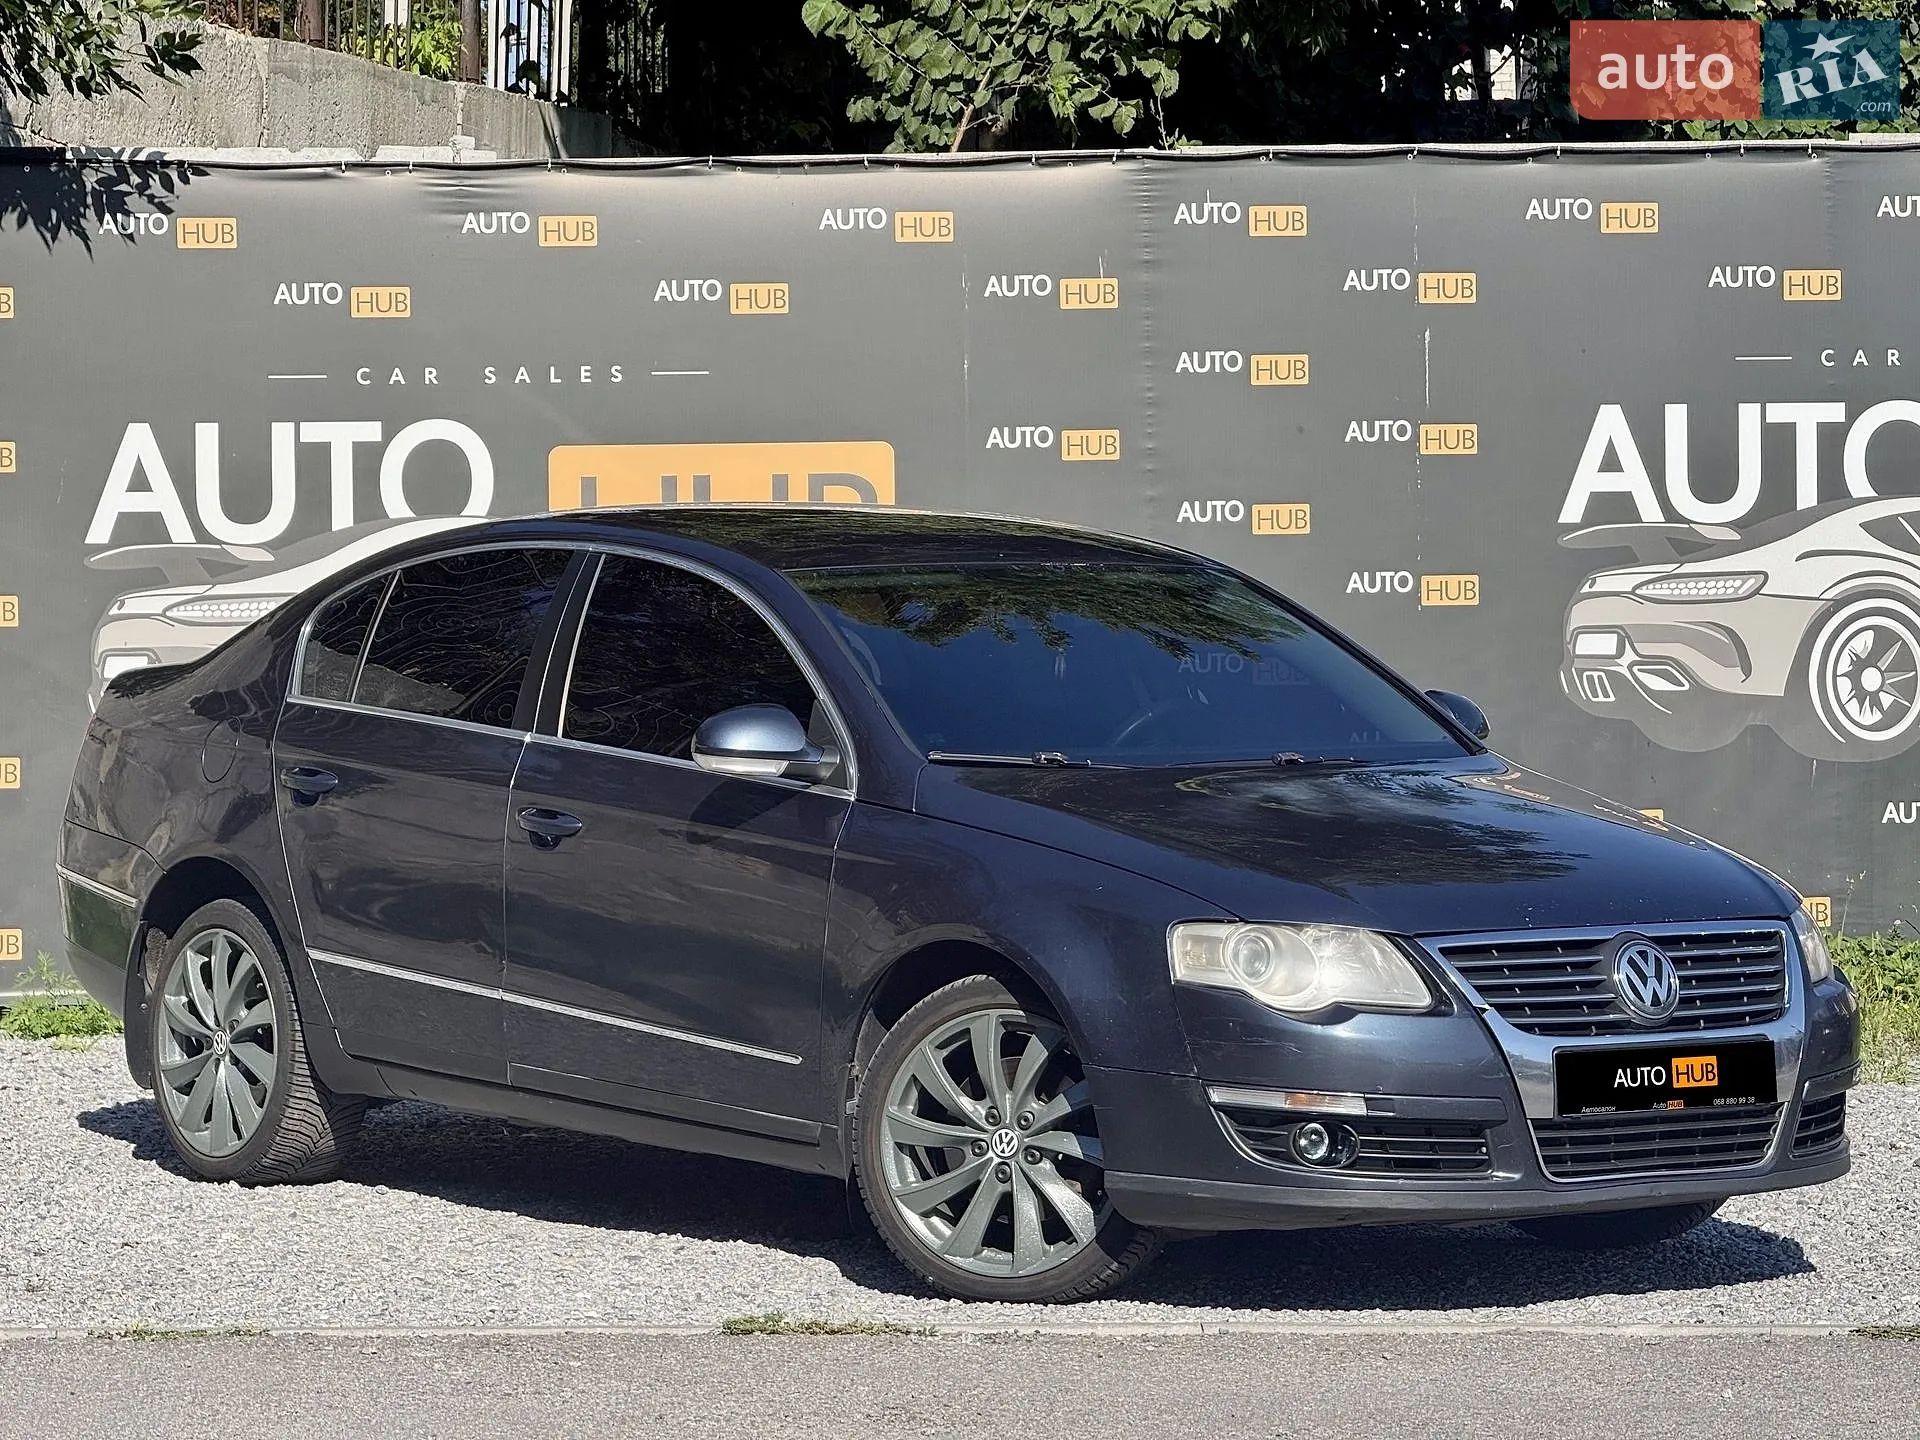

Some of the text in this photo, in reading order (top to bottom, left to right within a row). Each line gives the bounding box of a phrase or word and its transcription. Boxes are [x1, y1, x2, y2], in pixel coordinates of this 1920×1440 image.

[99, 212, 235, 244] AUTO HUB
[461, 211, 594, 243] AUTO HUB
[819, 207, 951, 238] AUTO HUB
[1174, 202, 1304, 232] AUTO HUB
[1525, 198, 1655, 229] AUTO HUB
[653, 279, 786, 310] AUTO HUB
[984, 275, 1115, 305] AUTO HUB
[1343, 268, 1473, 299] AUTO HUB
[1708, 265, 1839, 296] AUTO HUB
[274, 282, 410, 313] AUTO HUB
[1176, 351, 1306, 381] AUTO HUB
[1821, 349, 1901, 367] CAR
[356, 365, 623, 385] CAR SALES
[986, 426, 1119, 457] AUTO HUB
[1345, 420, 1475, 450] AUTO HUB
[84, 418, 495, 546] AUTO
[1177, 500, 1308, 531] AUTO HUB
[1346, 571, 1476, 601] AUTO HUB
[1613, 1062, 1717, 1088] AUTO HUB
[1668, 1101, 1683, 1109] HUB
